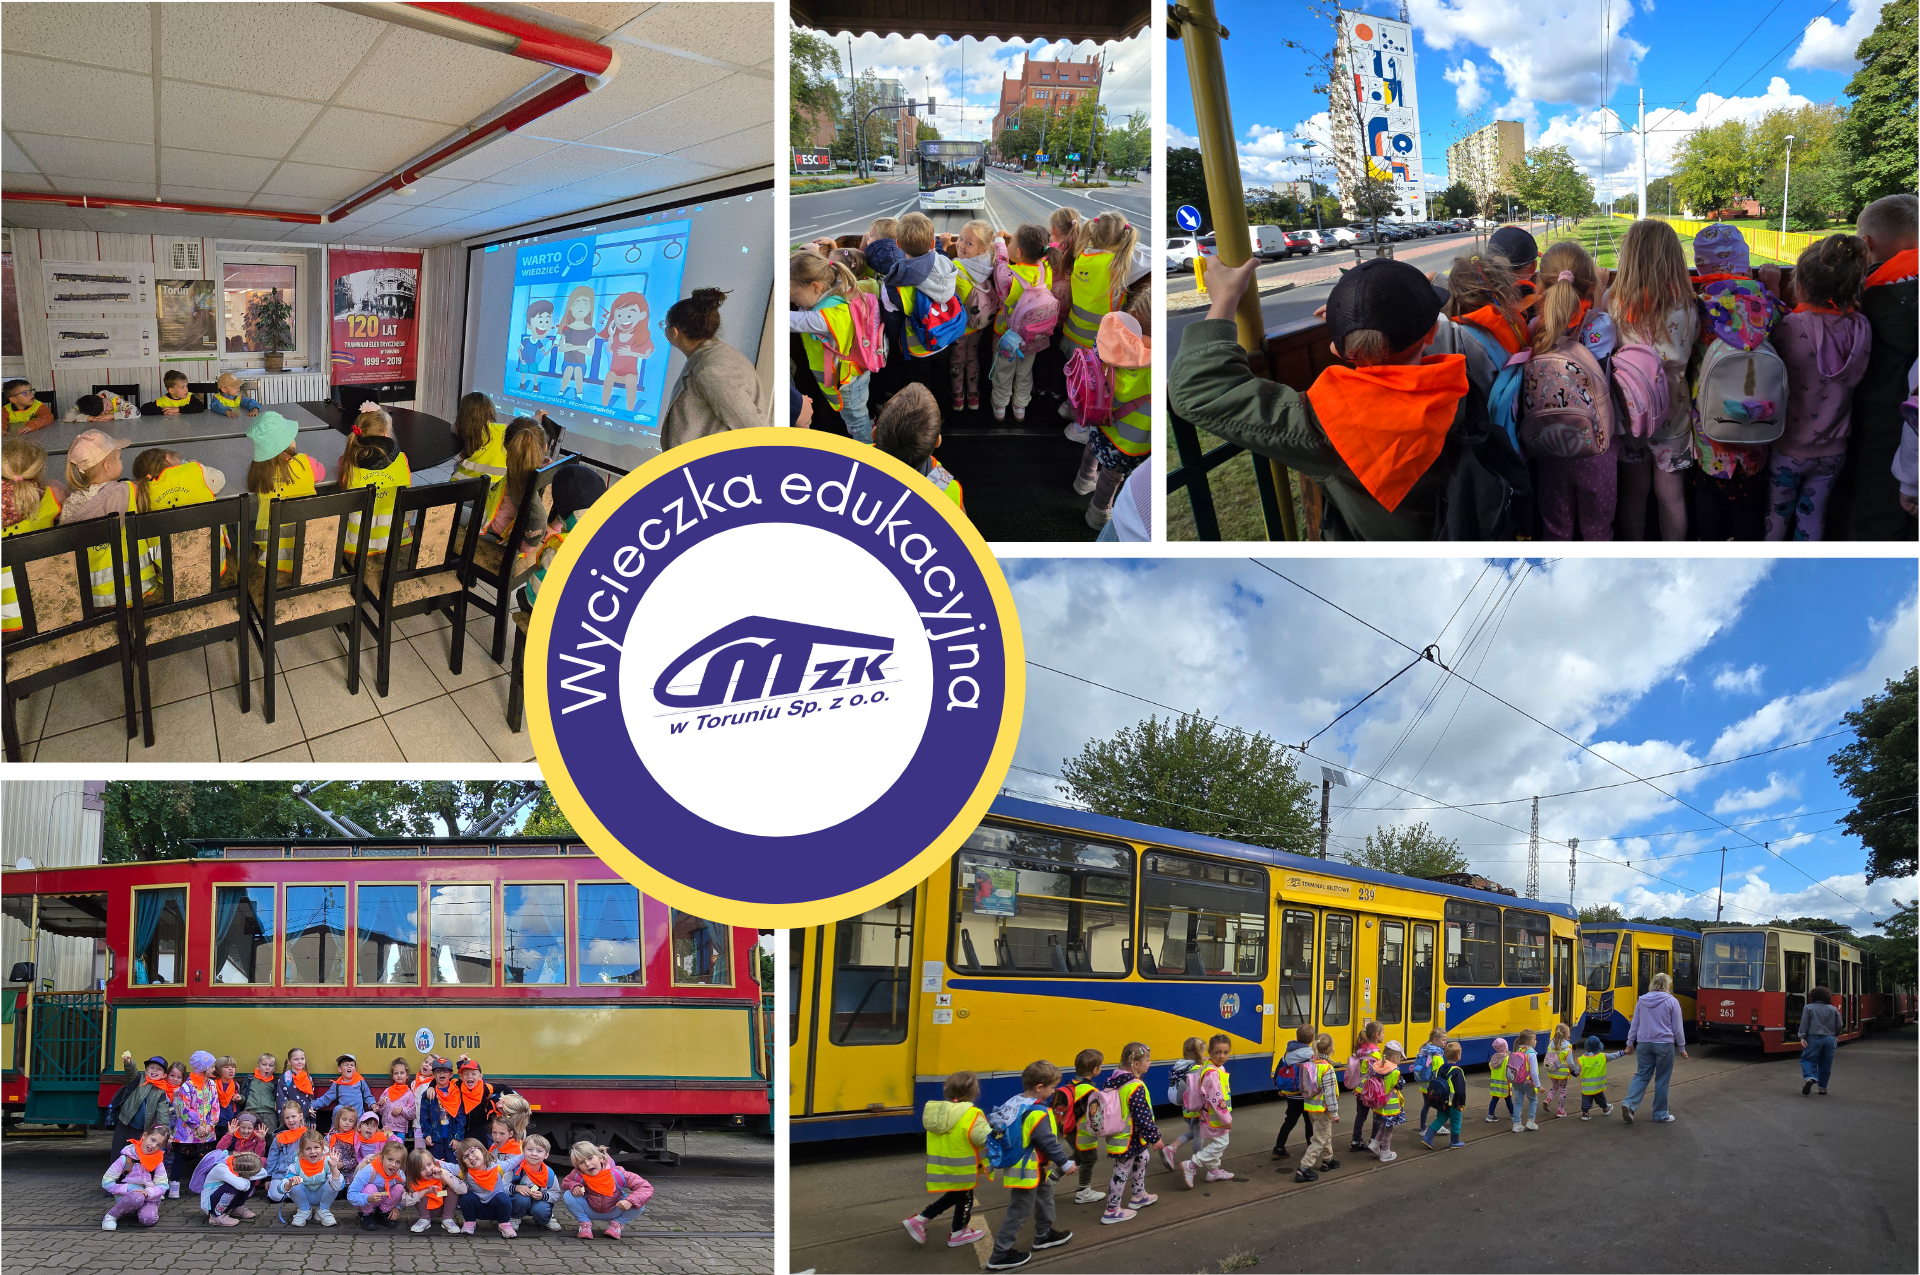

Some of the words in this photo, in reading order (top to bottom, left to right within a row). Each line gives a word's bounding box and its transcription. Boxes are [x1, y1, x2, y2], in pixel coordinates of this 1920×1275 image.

[929, 145, 939, 153] 32
[946, 145, 969, 153] LETNIA
[795, 154, 830, 165] RESCUE
[521, 251, 562, 267] WARTO
[521, 264, 560, 277] WIEDZIEĆ
[161, 285, 189, 295] Toruń
[347, 315, 379, 338] 120
[382, 324, 398, 336] LAT
[363, 357, 380, 366] 1899
[386, 357, 402, 366] 2019
[1302, 881, 1326, 890] TERMINAL
[1326, 884, 1350, 893] BILETOWY
[1358, 887, 1375, 901] 239
[1720, 1008, 1734, 1018] 263
[375, 1032, 406, 1048] MZK
[443, 1031, 480, 1048] Toruń
